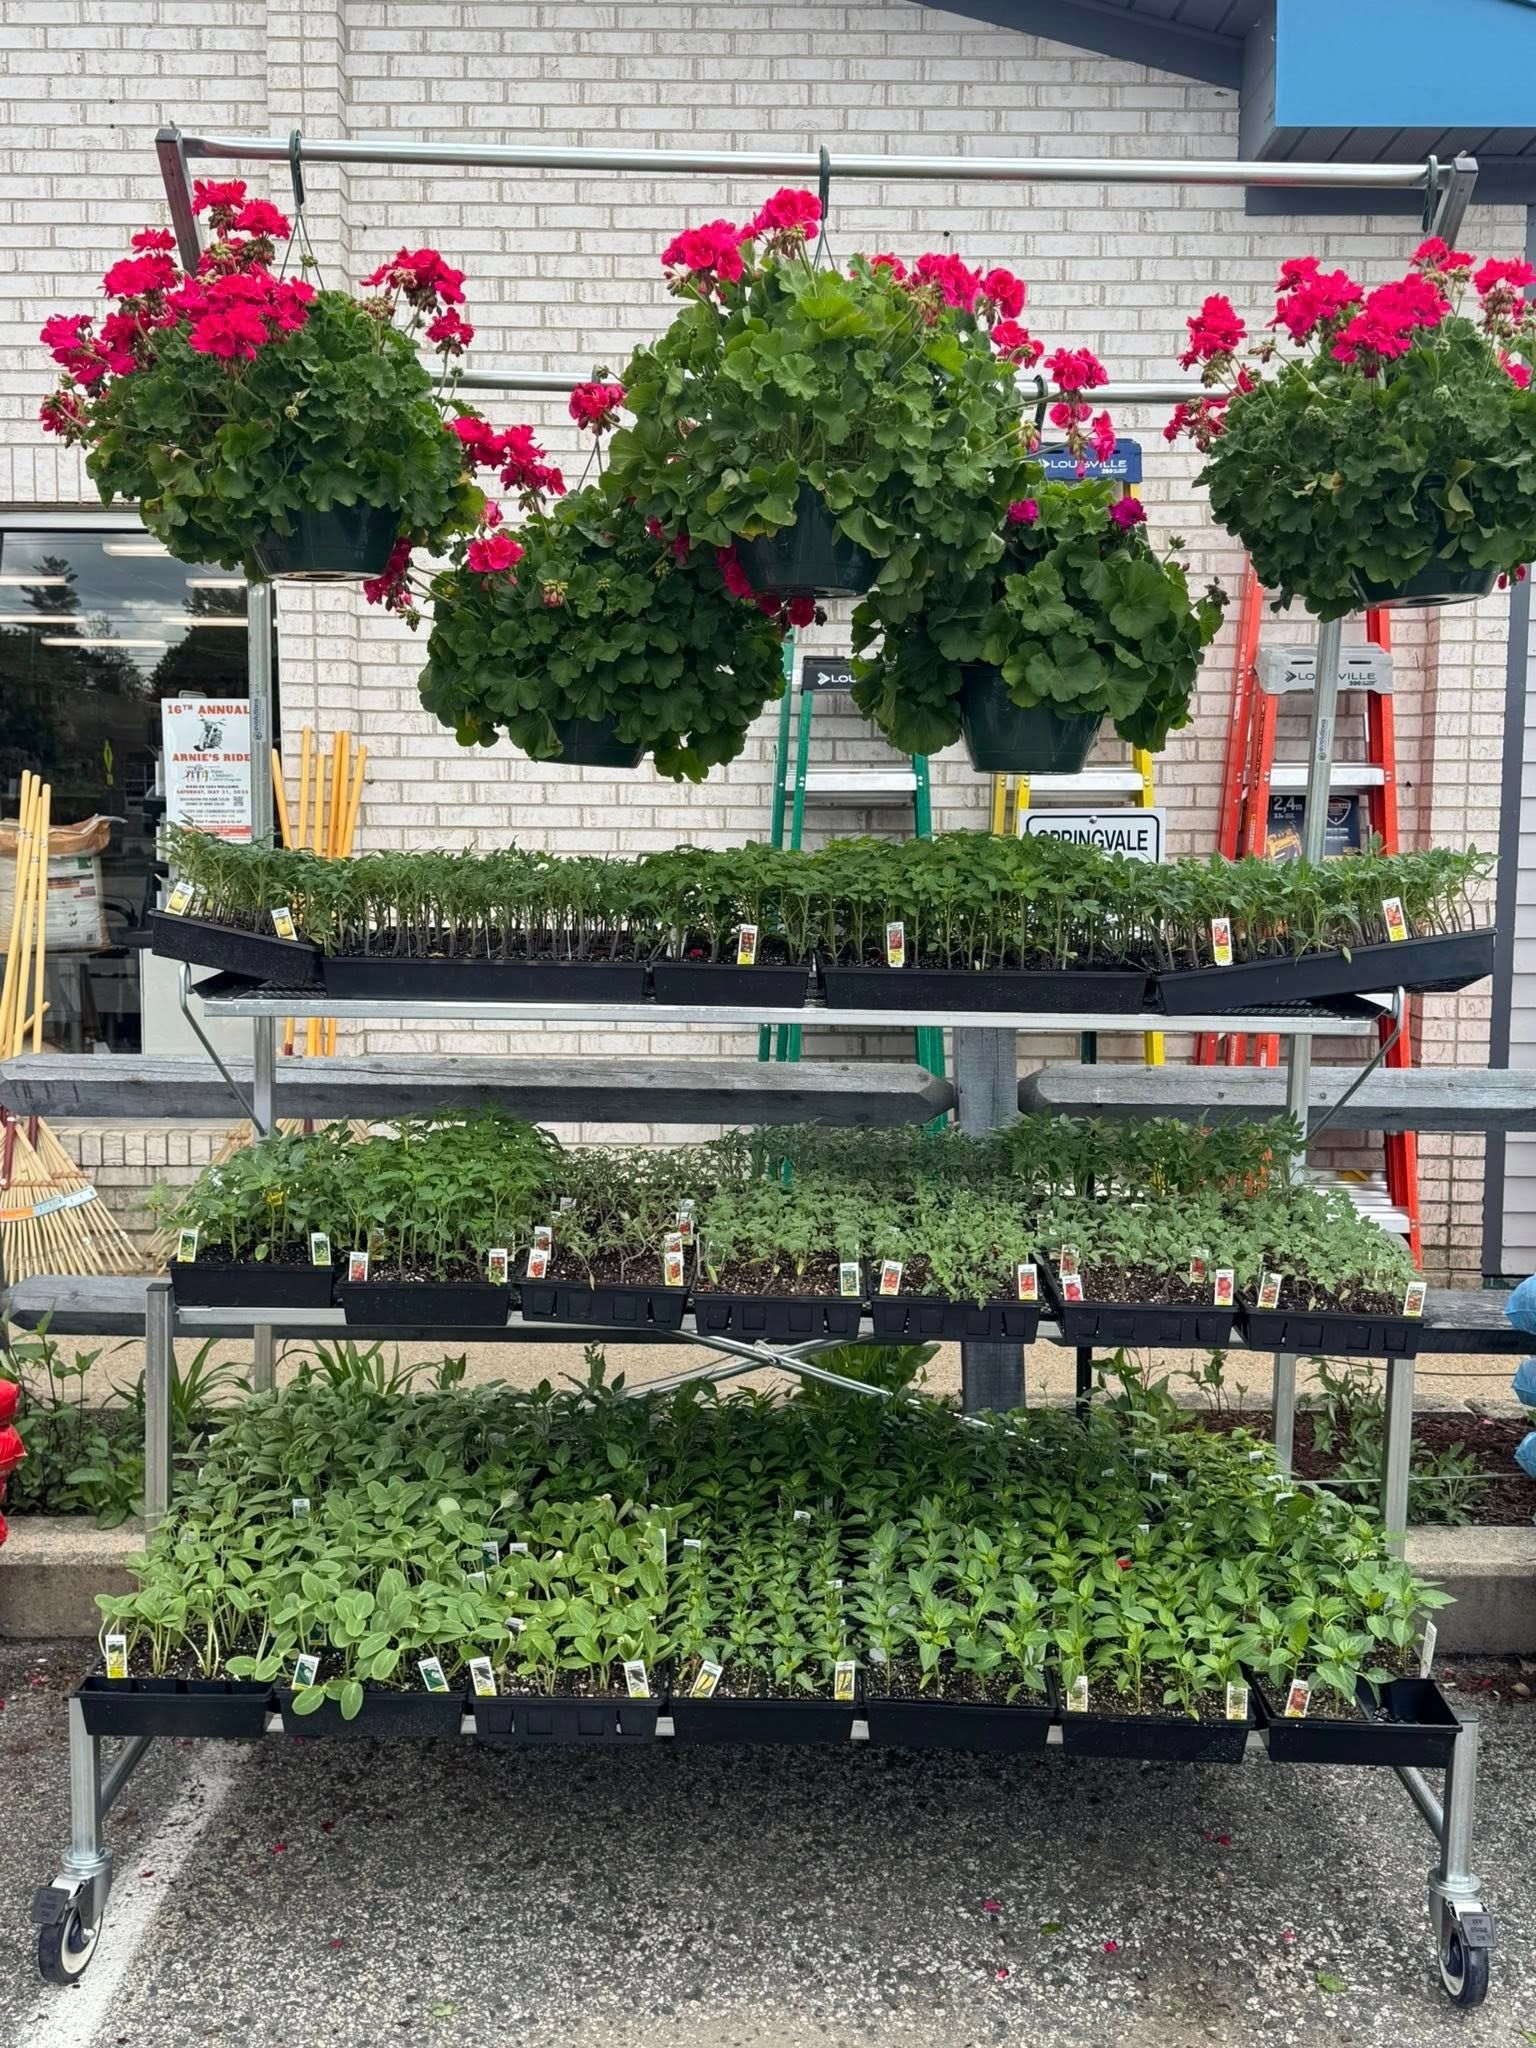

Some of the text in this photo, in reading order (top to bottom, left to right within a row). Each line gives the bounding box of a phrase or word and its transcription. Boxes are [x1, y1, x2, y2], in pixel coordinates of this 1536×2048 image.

[1051, 459, 1127, 469] LOUSVILLE
[167, 704, 250, 715] 16TH ANNUAL
[172, 753, 251, 762] ARNIE'S RIDE
